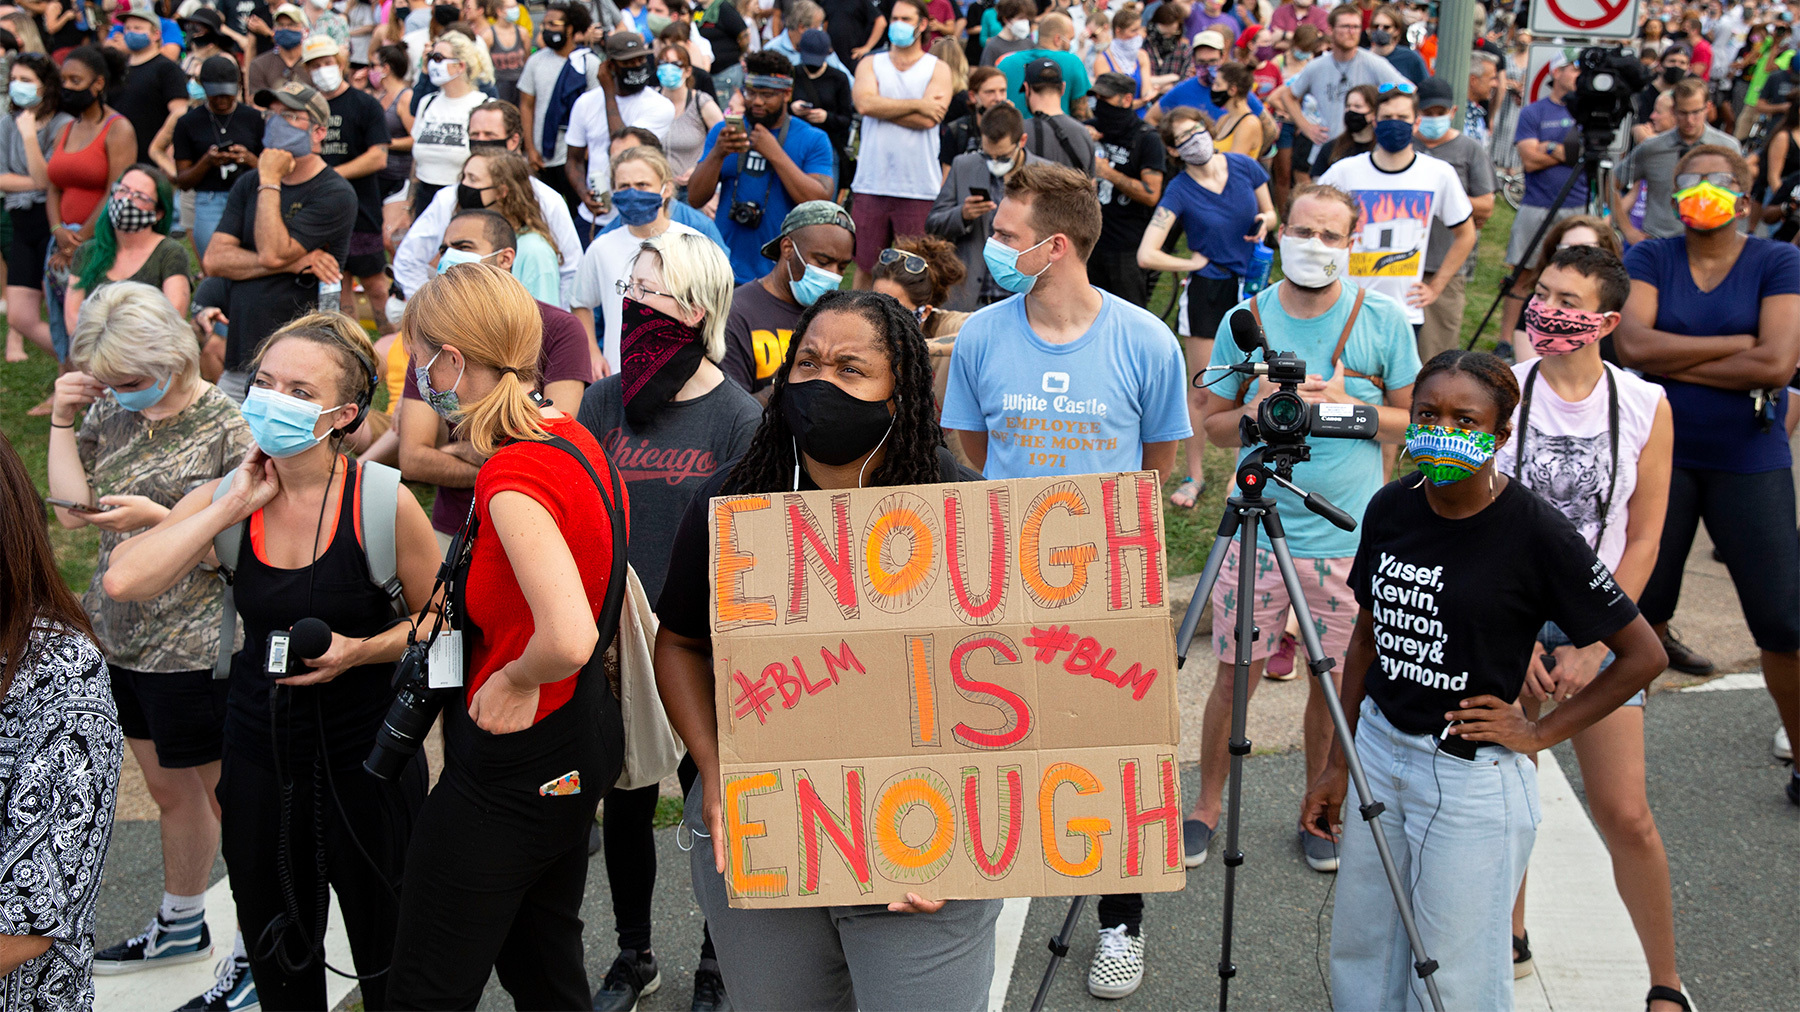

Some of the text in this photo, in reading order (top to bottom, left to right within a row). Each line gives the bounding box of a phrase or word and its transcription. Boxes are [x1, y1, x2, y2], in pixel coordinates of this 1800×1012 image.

[1002, 393, 1107, 417] White Castle
[1005, 417, 1101, 434] EMPLOYEE
[601, 427, 717, 485] Chicago
[990, 429, 1118, 451] OF THE MONTH
[1028, 452, 1067, 468] 1971
[714, 472, 1164, 632] ENOUGH
[1378, 552, 1444, 592] Yusef,
[1371, 574, 1439, 616] Kevin,
[1373, 599, 1448, 643] Antron,
[733, 638, 867, 725] #BLM
[1022, 624, 1159, 701] #BLM
[1375, 644, 1468, 692] aymond
[903, 631, 1036, 751] IS
[722, 753, 1185, 899] ENOUGH
